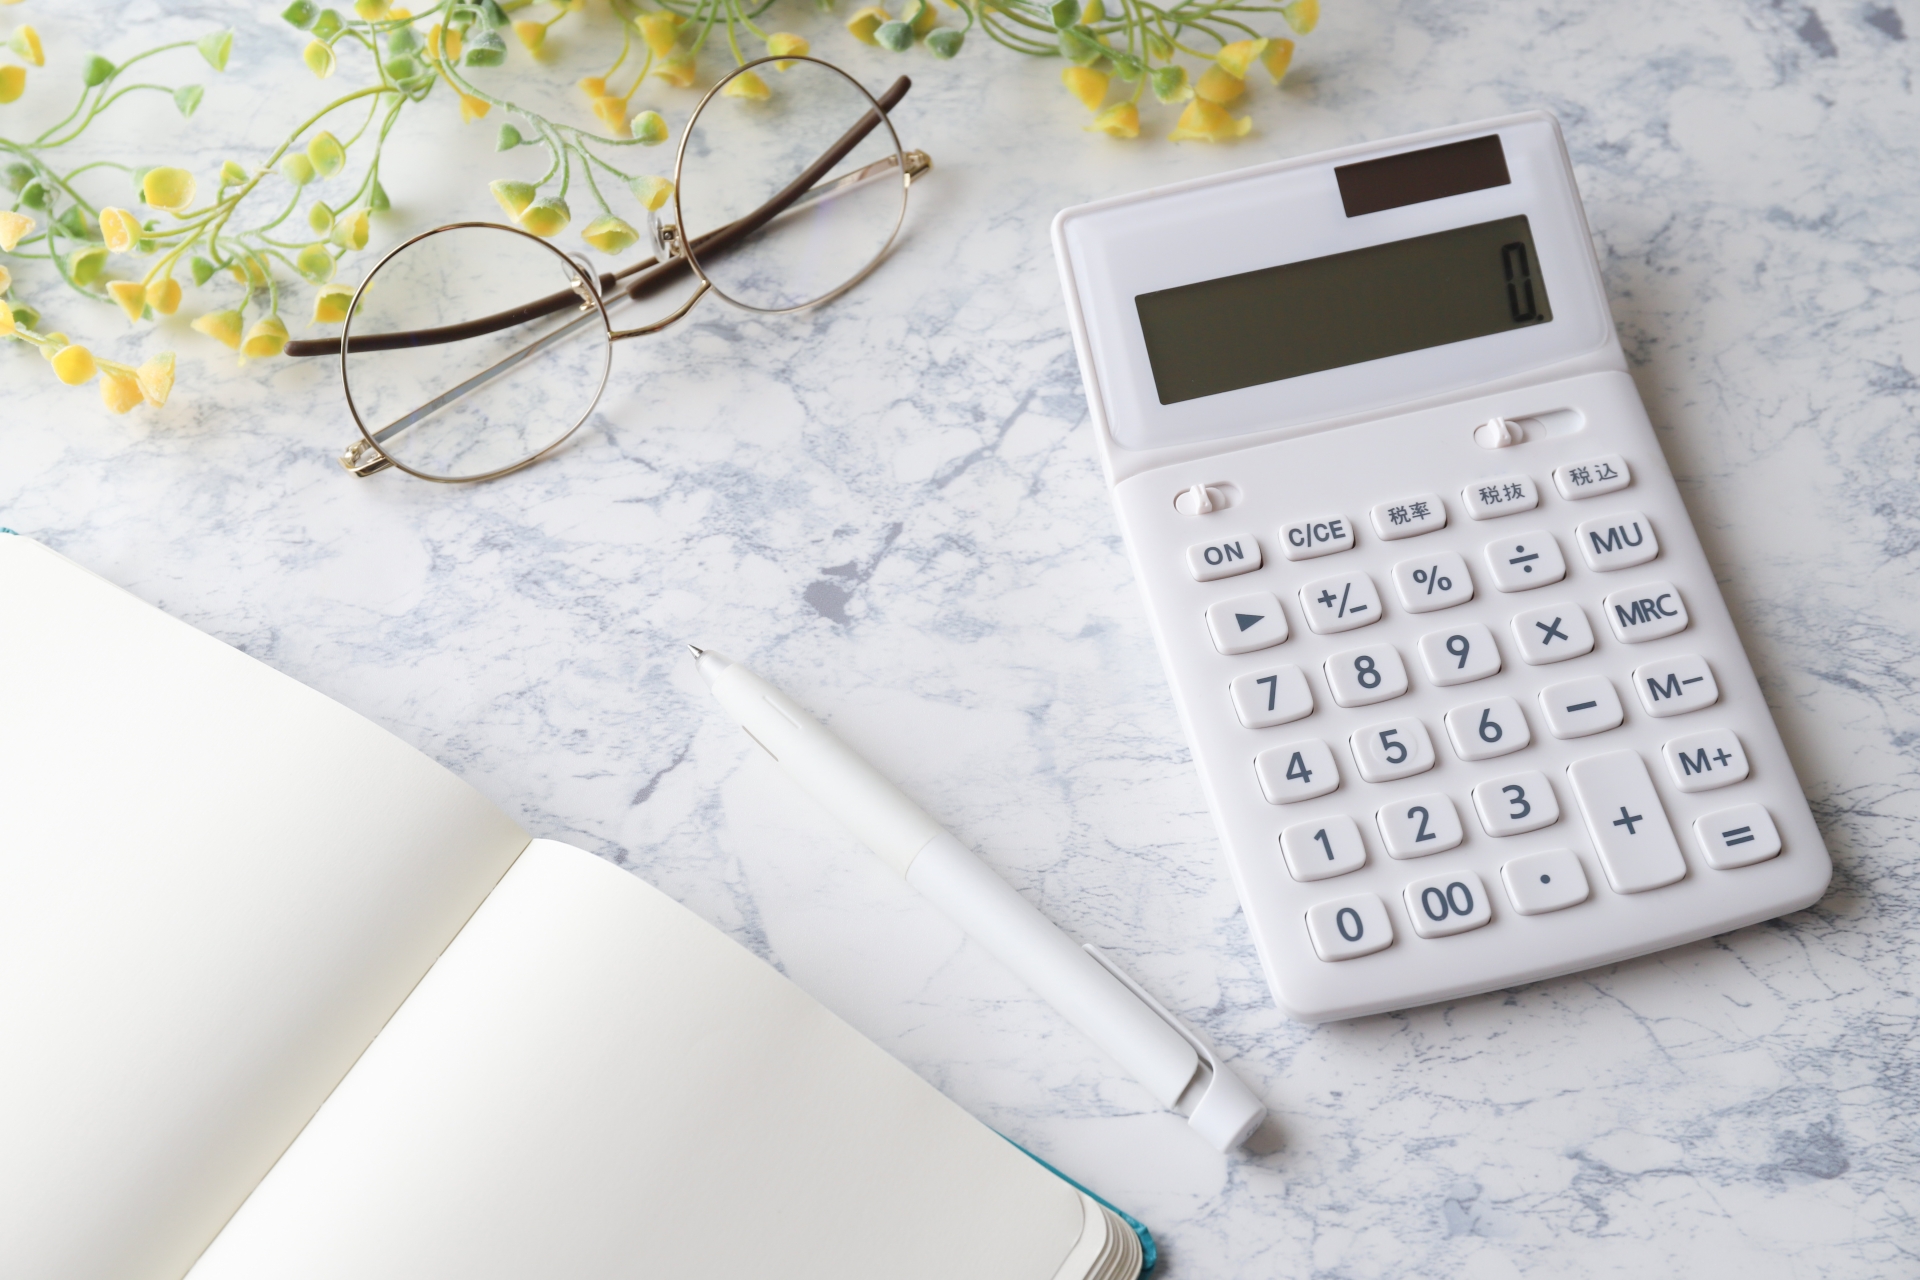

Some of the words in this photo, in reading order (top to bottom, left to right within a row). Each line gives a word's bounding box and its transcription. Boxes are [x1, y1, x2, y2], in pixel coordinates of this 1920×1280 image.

[1568, 462, 1619, 487] 税込
[1478, 482, 1526, 506] 税抜
[1387, 501, 1432, 526] 税率
[1288, 519, 1347, 548] C/CE
[1588, 521, 1644, 555] MU
[1203, 541, 1245, 566] ON
[1412, 565, 1453, 596] %
[1317, 582, 1368, 619] +/-
[1614, 593, 1679, 628] MRC
[1445, 634, 1470, 670] 9
[1353, 655, 1382, 690] 8
[1646, 672, 1704, 702] M-
[1255, 674, 1278, 712] 7
[1478, 707, 1503, 744] 6
[1378, 728, 1408, 765] 5
[1678, 747, 1733, 776] M+
[1285, 751, 1313, 784] 4
[1501, 784, 1531, 820] 3
[1407, 805, 1437, 843] 2
[1313, 828, 1335, 861] 1
[1421, 881, 1474, 922] 00
[1335, 907, 1364, 943] 0
